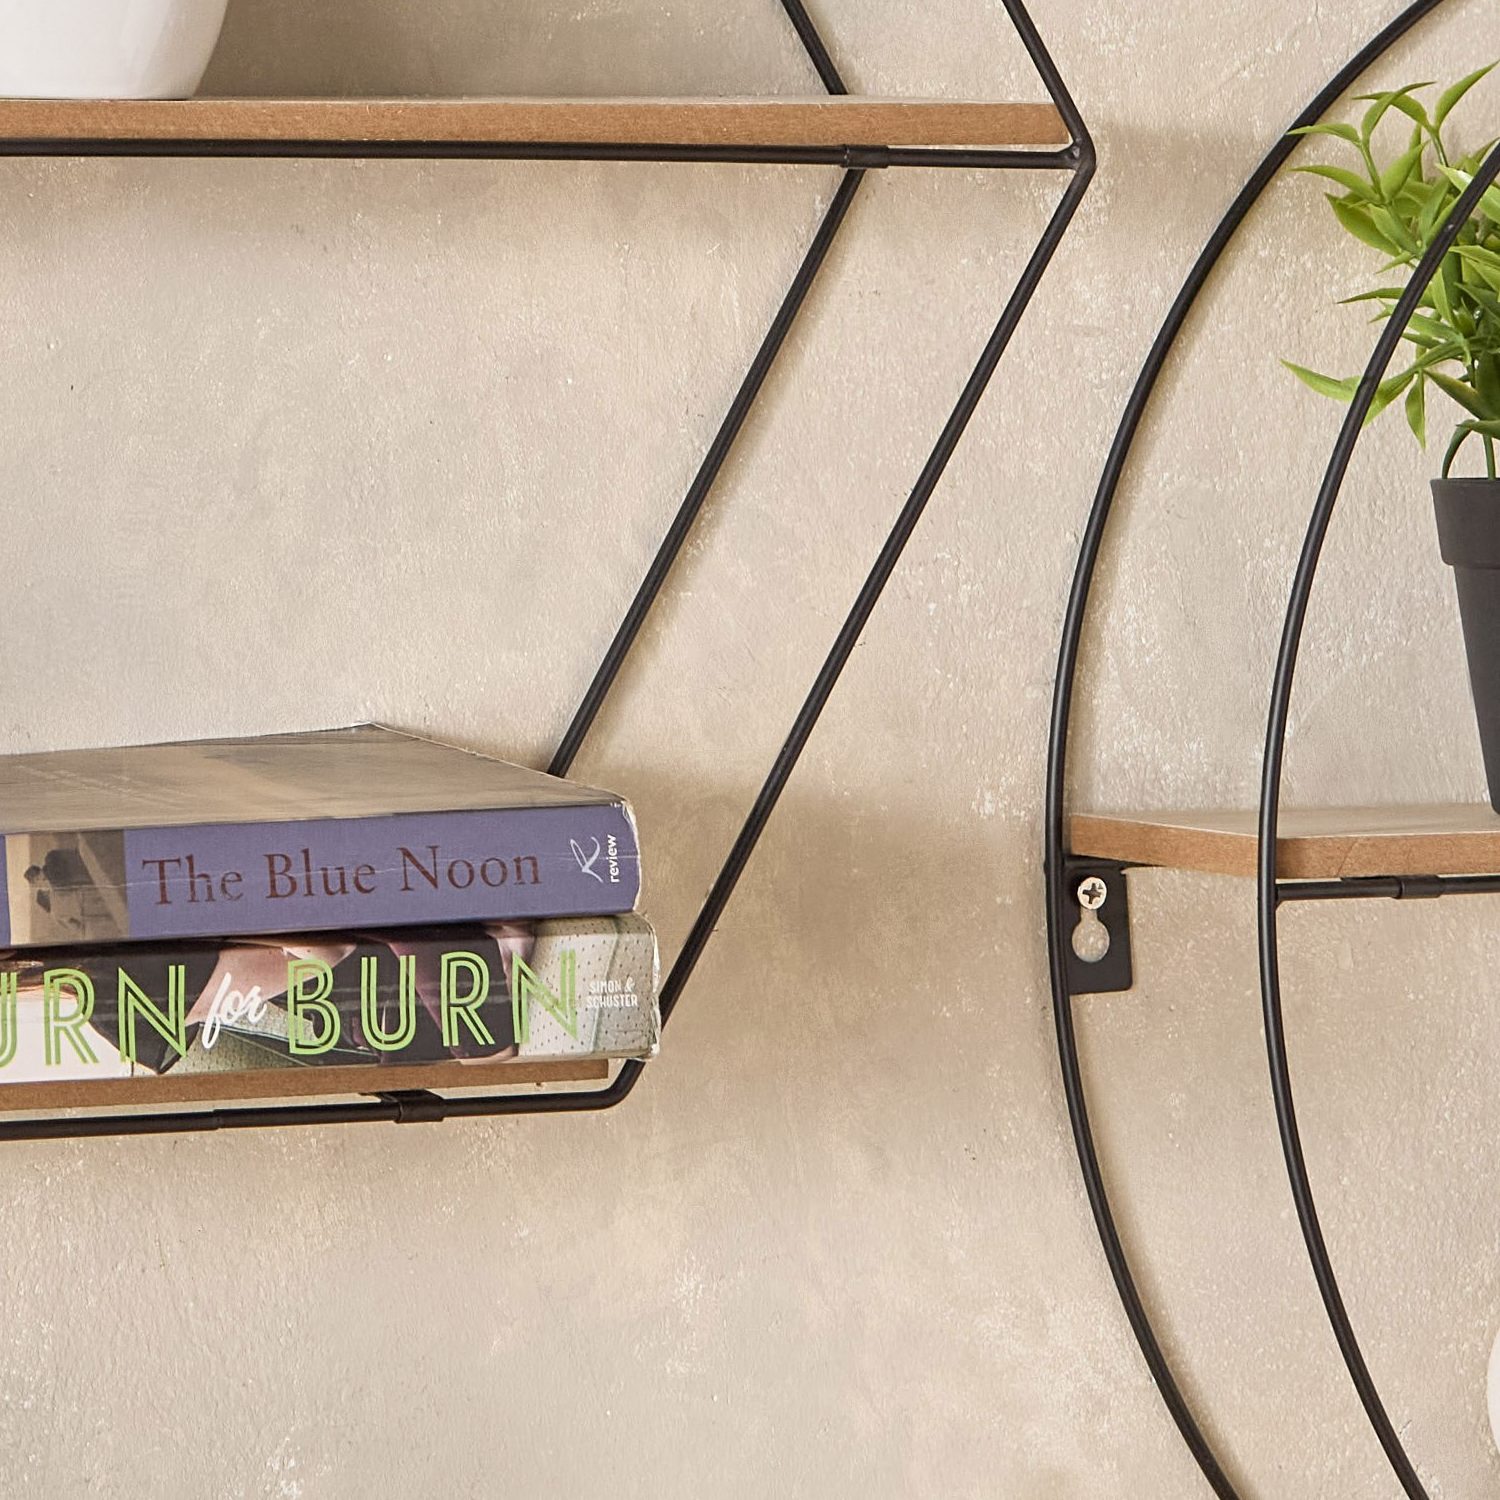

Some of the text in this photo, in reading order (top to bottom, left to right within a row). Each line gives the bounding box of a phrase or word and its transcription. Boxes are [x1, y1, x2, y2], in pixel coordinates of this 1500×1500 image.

[141, 845, 542, 905] The Blue Noon
[606, 834, 620, 883] review
[202, 972, 267, 1049] for
[287, 949, 578, 1054] BURN
[586, 994, 638, 1008] SCHUSTER
[589, 976, 635, 993] SIMON &
